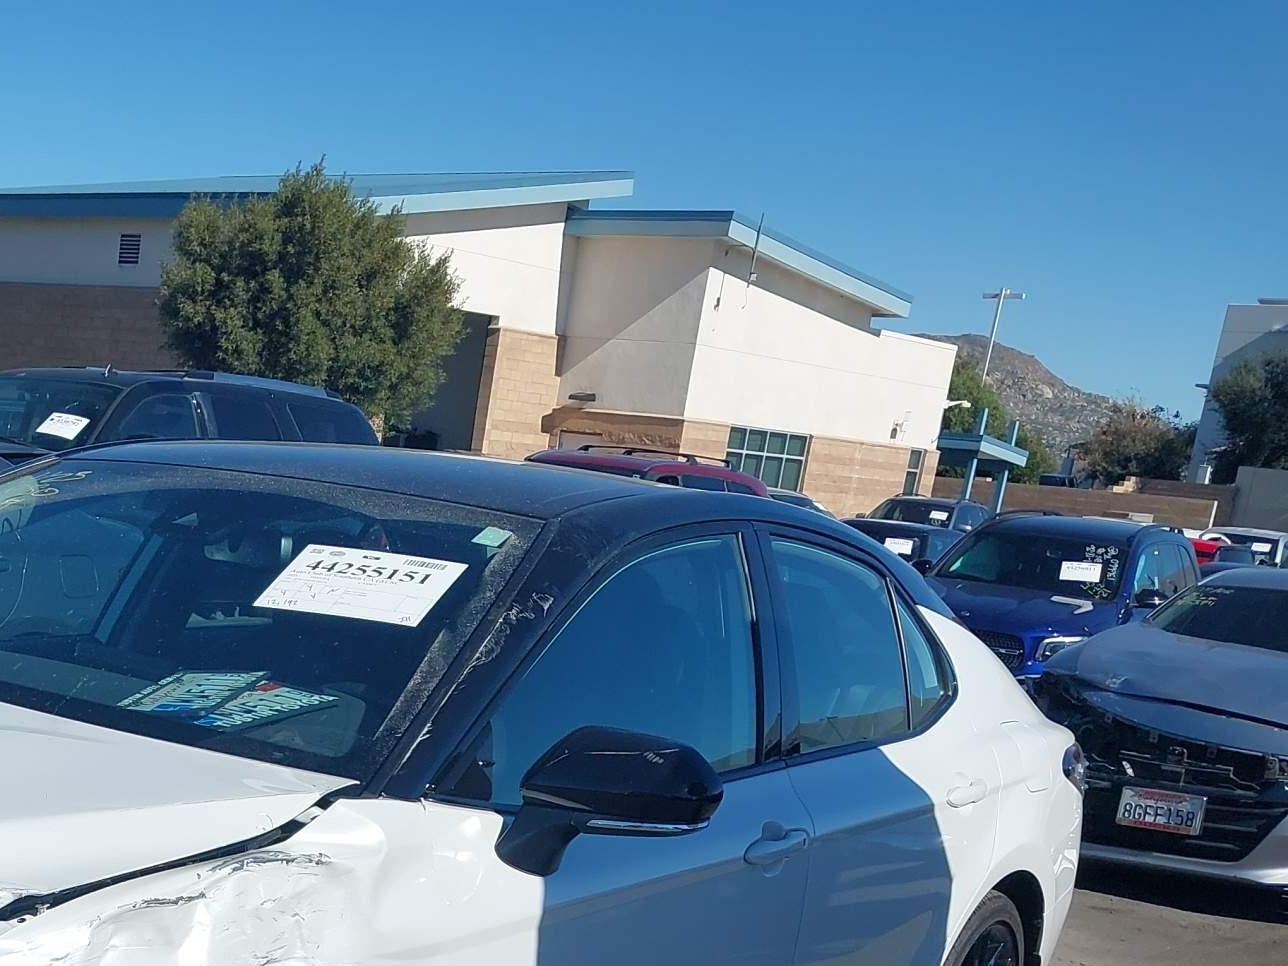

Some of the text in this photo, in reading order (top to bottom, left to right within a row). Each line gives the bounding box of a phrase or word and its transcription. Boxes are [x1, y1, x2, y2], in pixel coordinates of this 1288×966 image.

[306, 559, 432, 585] 44255151
[271, 694, 340, 712] TOYOTA
[1122, 801, 1196, 828] 8GFF158
